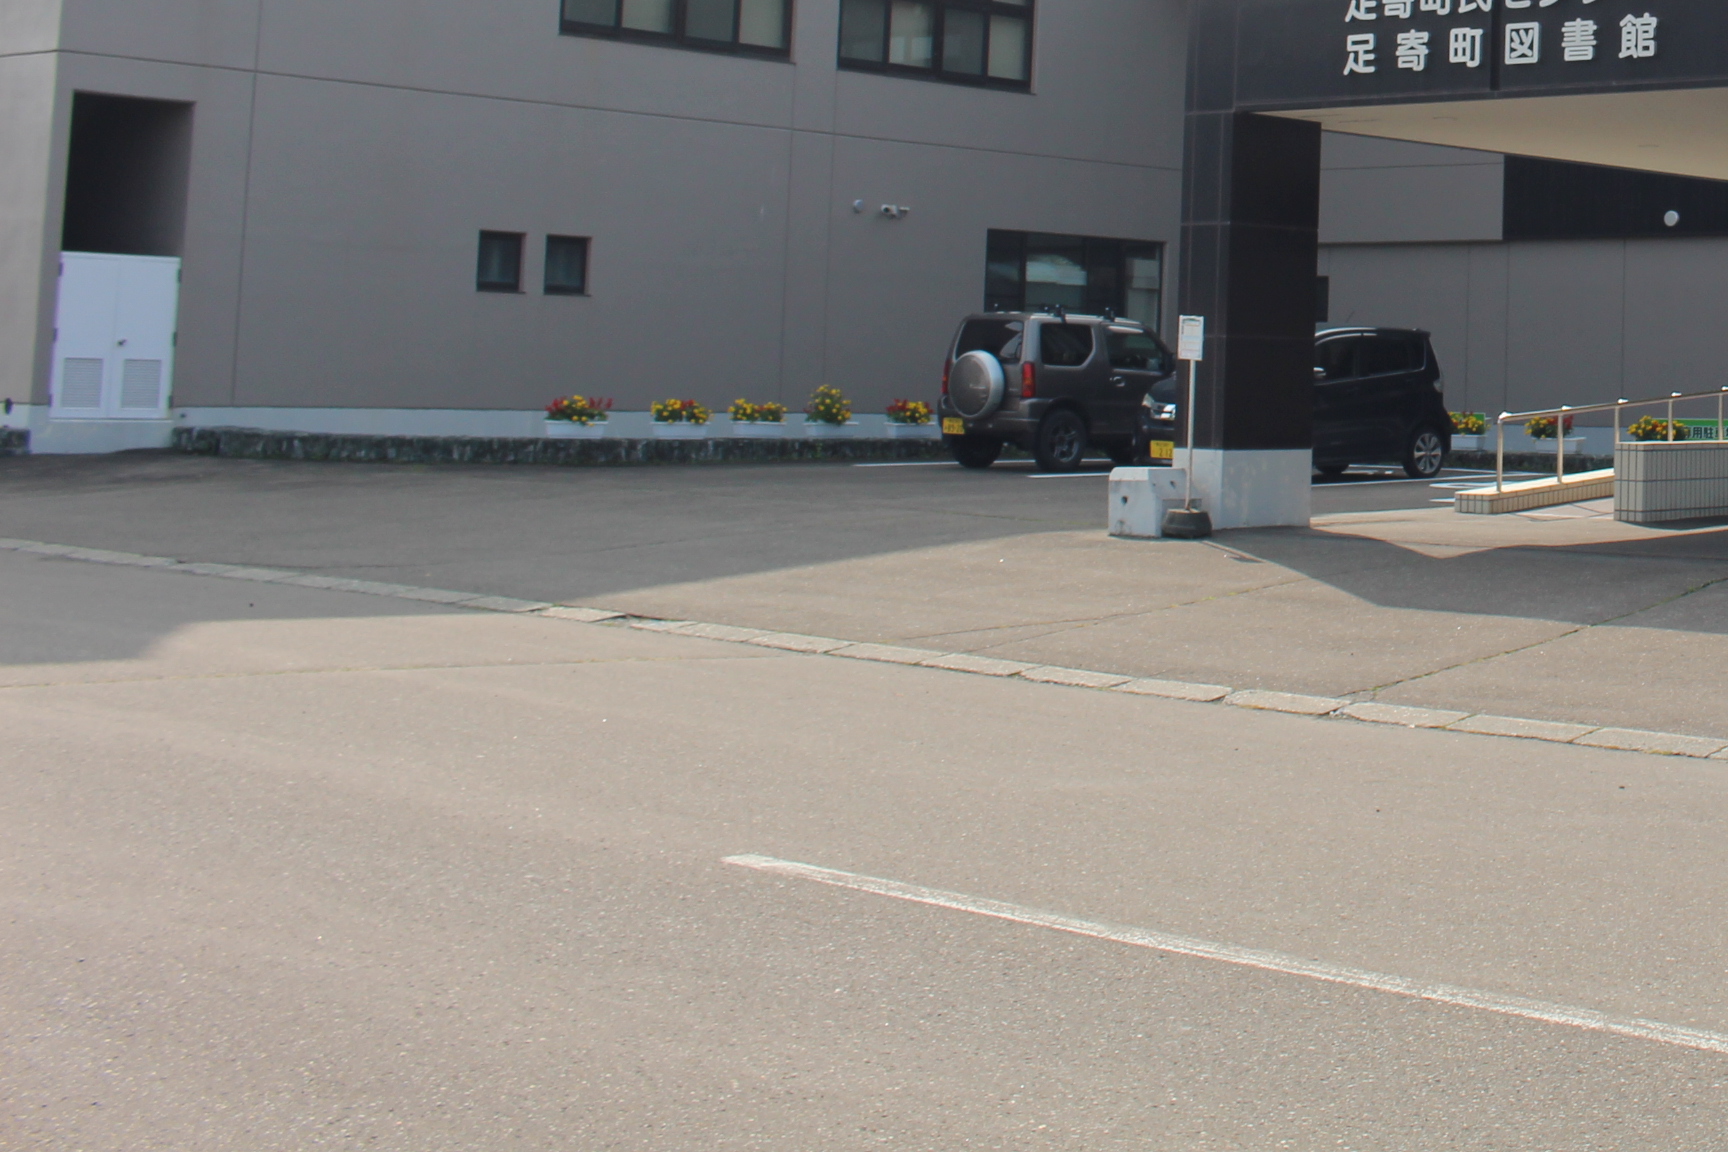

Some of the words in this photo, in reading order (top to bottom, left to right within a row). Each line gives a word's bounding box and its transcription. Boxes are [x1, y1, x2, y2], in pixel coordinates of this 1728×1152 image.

[1343, 12, 1657, 75] 足寄町図書館
